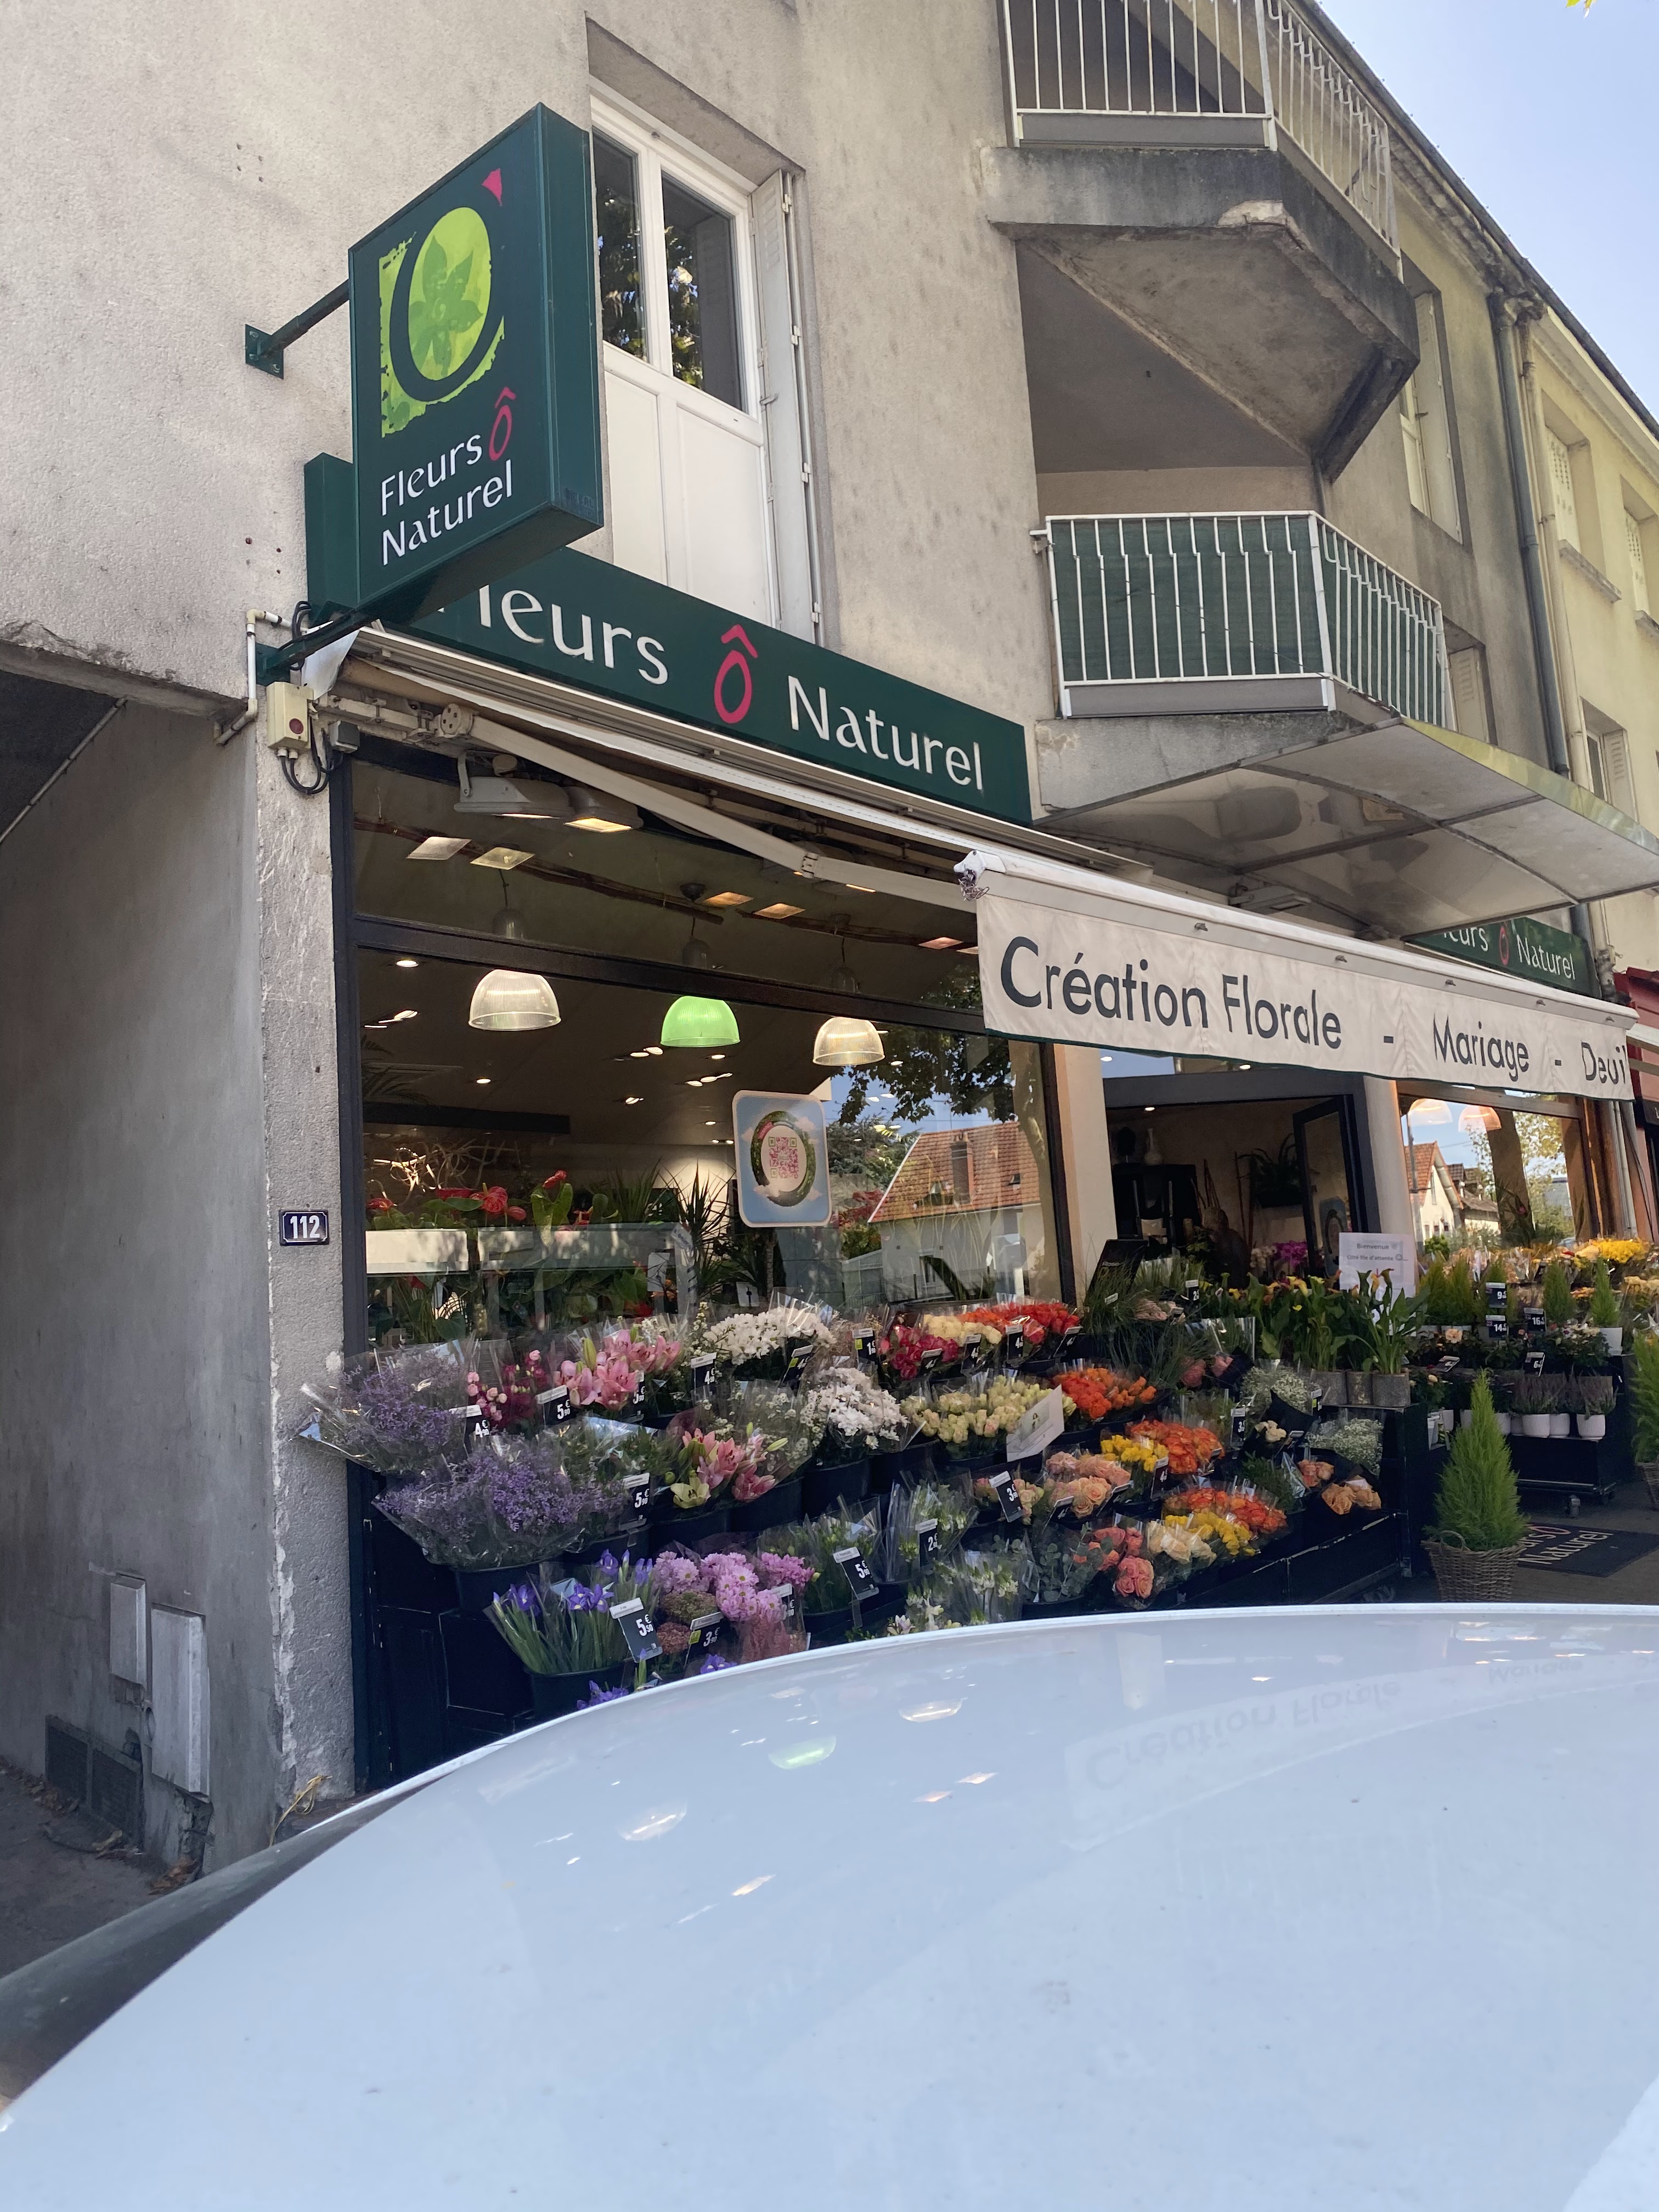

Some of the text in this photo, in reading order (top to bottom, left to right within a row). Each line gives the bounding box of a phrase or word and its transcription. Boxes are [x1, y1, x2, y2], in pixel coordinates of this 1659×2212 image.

[381, 386, 517, 516] Fleurs Ô
[381, 460, 512, 566] Naturel
[438, 585, 983, 790] leurs Ô Naturel
[1001, 936, 1209, 1028] Création
[1222, 974, 1342, 1049] Florale
[1432, 1013, 1529, 1082] Mariage
[1516, 934, 1575, 980] Naturel
[290, 1215, 320, 1239] 112
[1517, 1530, 1613, 1565] Naturel
